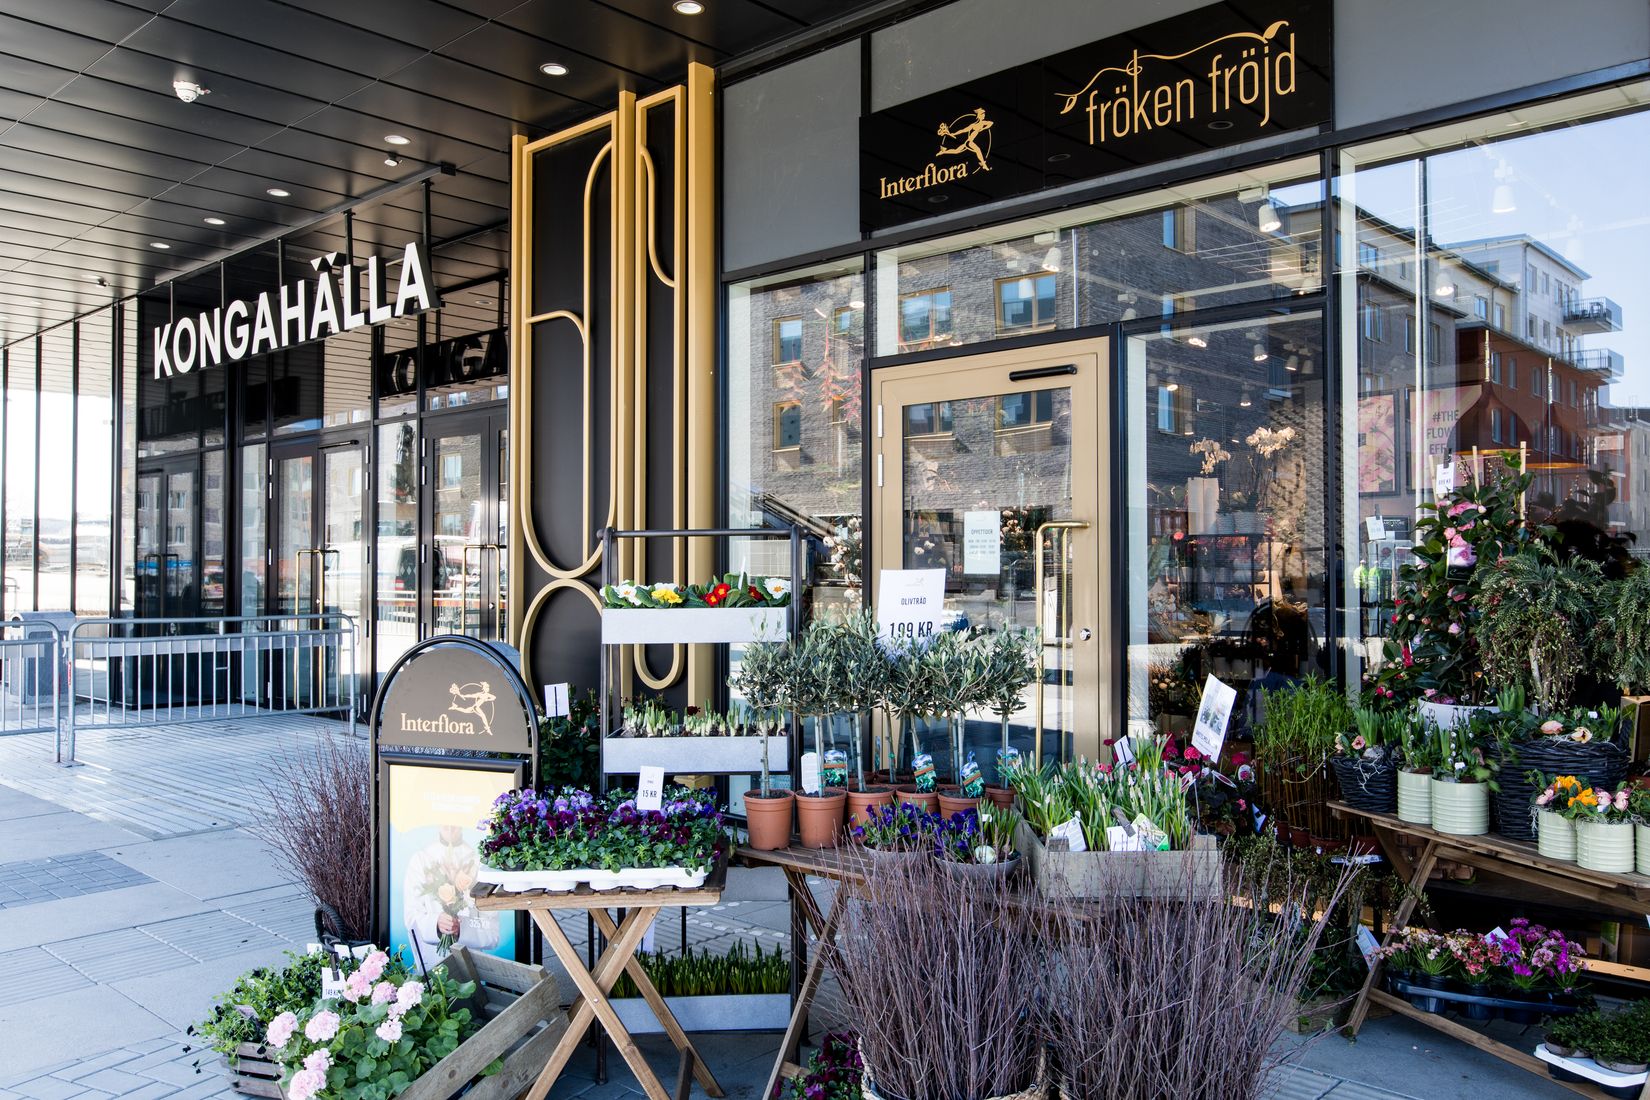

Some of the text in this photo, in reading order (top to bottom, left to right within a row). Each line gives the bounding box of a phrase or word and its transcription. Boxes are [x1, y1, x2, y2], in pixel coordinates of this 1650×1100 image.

[1086, 32, 1296, 145] fröken fröjd
[879, 162, 969, 200] Interflora
[153, 241, 431, 380] KONGAHÄLLA
[889, 620, 934, 639] 199 KR
[400, 712, 476, 735] Interflora
[650, 790, 658, 798] KR
